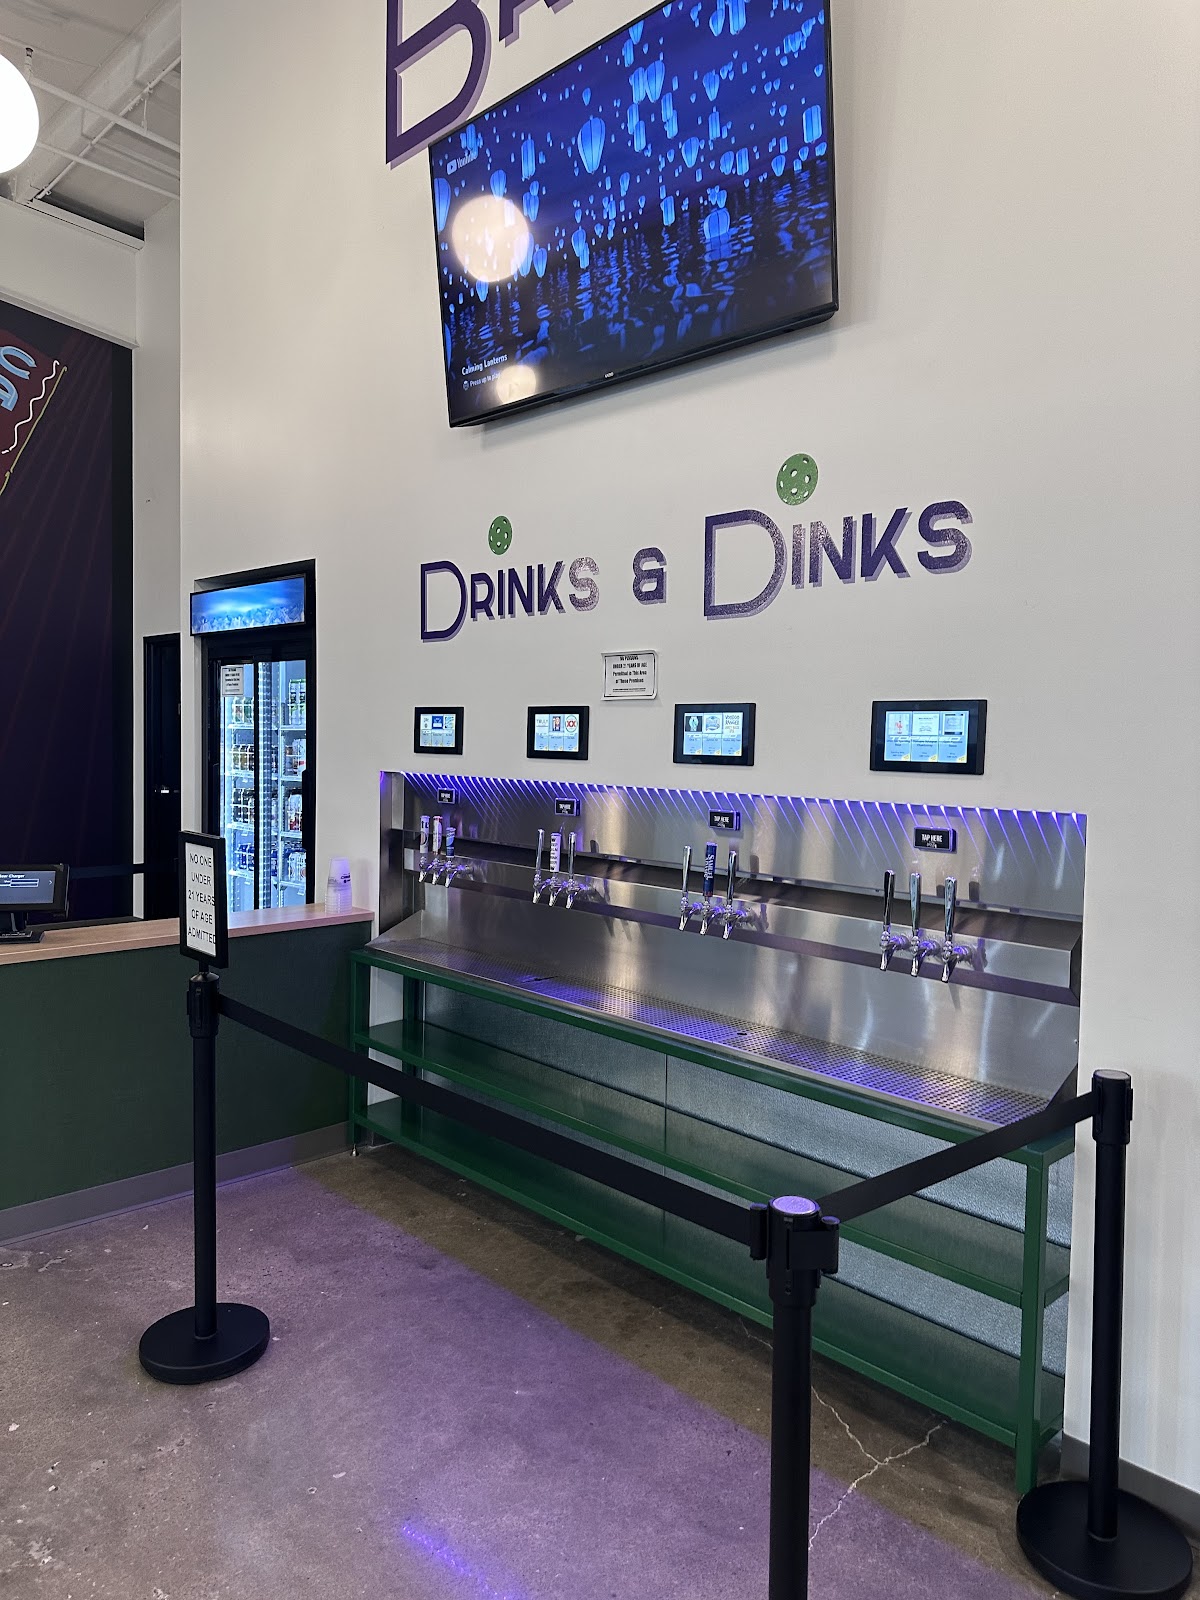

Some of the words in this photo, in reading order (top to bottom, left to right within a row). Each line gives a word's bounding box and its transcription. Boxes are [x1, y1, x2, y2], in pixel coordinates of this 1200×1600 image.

[461, 363, 483, 375] Calming
[484, 354, 508, 367] Lanterns
[421, 557, 600, 643] DRINKS
[632, 547, 667, 605] &
[704, 500, 974, 621] DINKS
[921, 833, 931, 841] TAP
[930, 834, 943, 843] HERE
[189, 852, 199, 864] NO
[199, 855, 212, 868] ONE
[191, 871, 212, 886] UNDER
[188, 889, 195, 901] 21
[195, 891, 216, 907] YEARS
[191, 909, 199, 920] OF
[200, 912, 213, 925] AGE
[187, 926, 216, 944] ADMITTED
